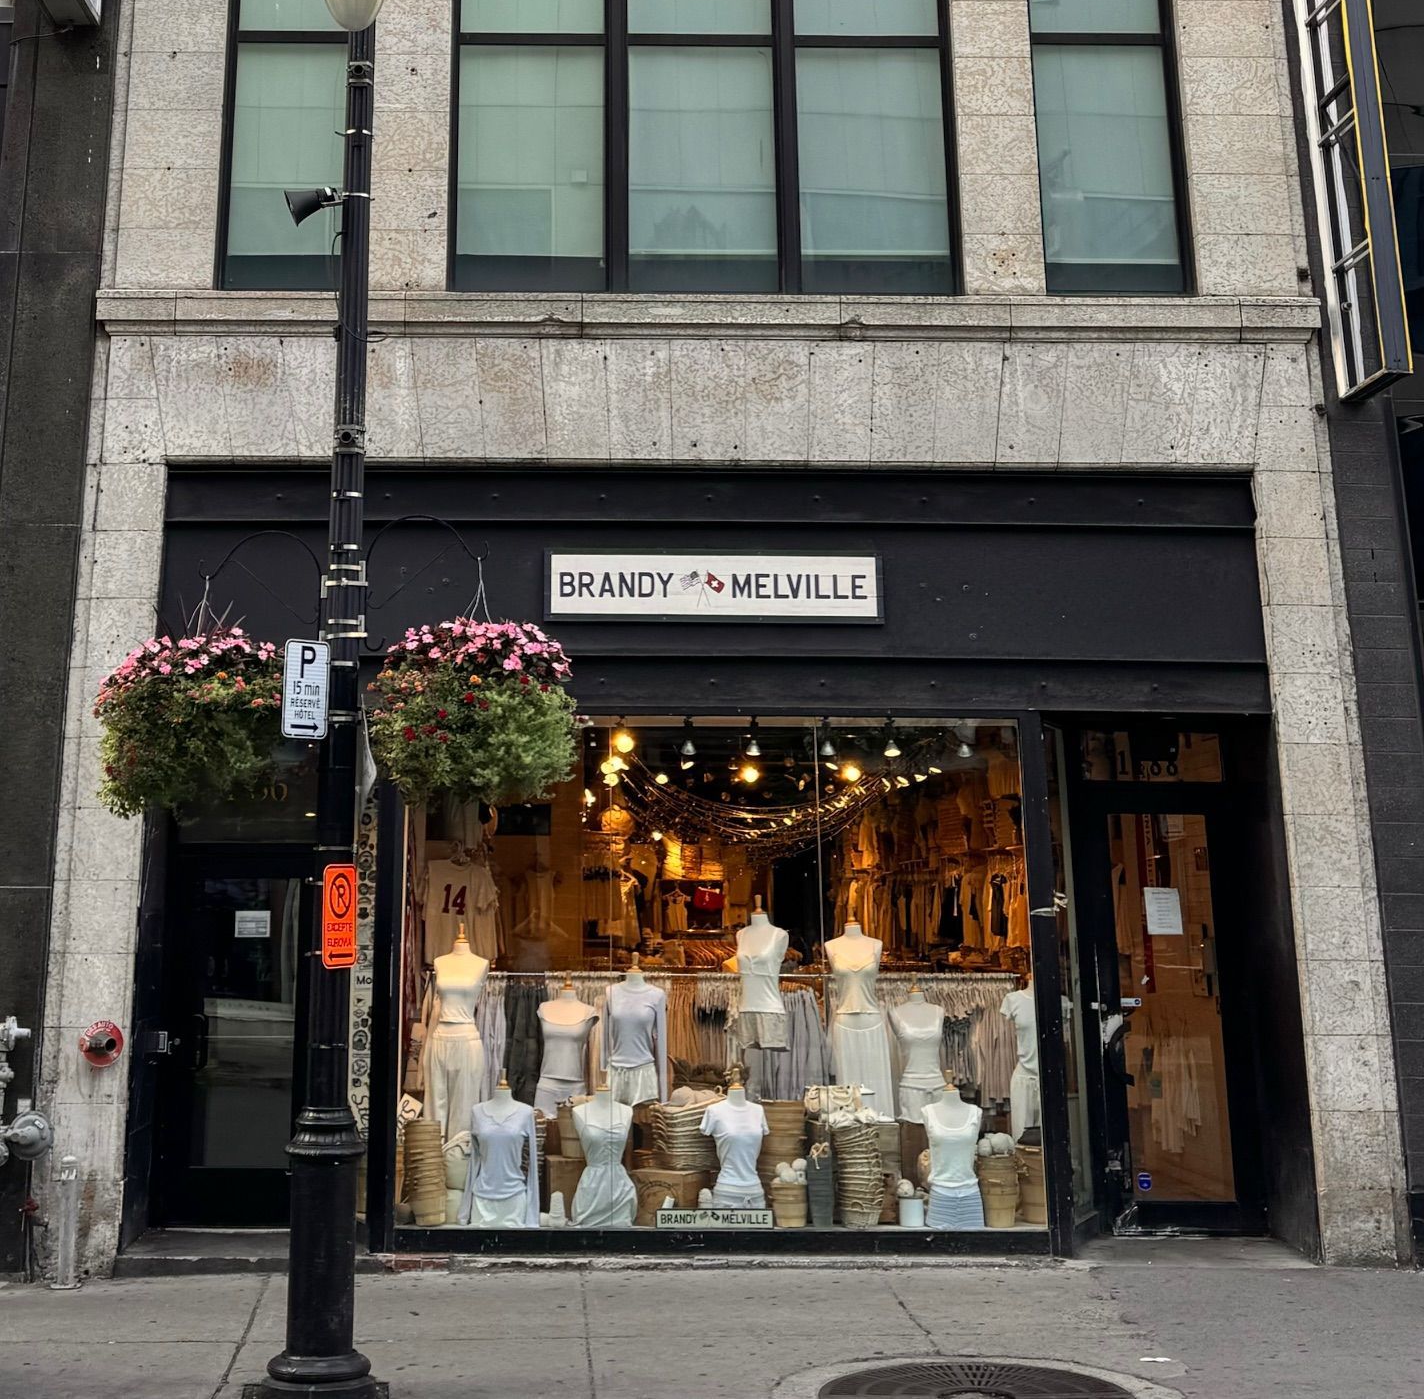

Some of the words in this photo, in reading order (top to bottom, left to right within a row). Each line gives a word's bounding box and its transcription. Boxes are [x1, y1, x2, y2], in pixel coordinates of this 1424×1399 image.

[558, 571, 674, 599] BRANDY
[731, 573, 868, 600] MELVILLE
[300, 645, 317, 679] P
[292, 680, 302, 695] 15
[304, 681, 320, 696] min
[290, 696, 321, 709] RÉSERVÉ
[294, 709, 316, 720] HÔTEL
[441, 883, 467, 916] 14
[660, 1213, 698, 1225] BRANDY
[721, 1213, 769, 1225] MELVILLE
